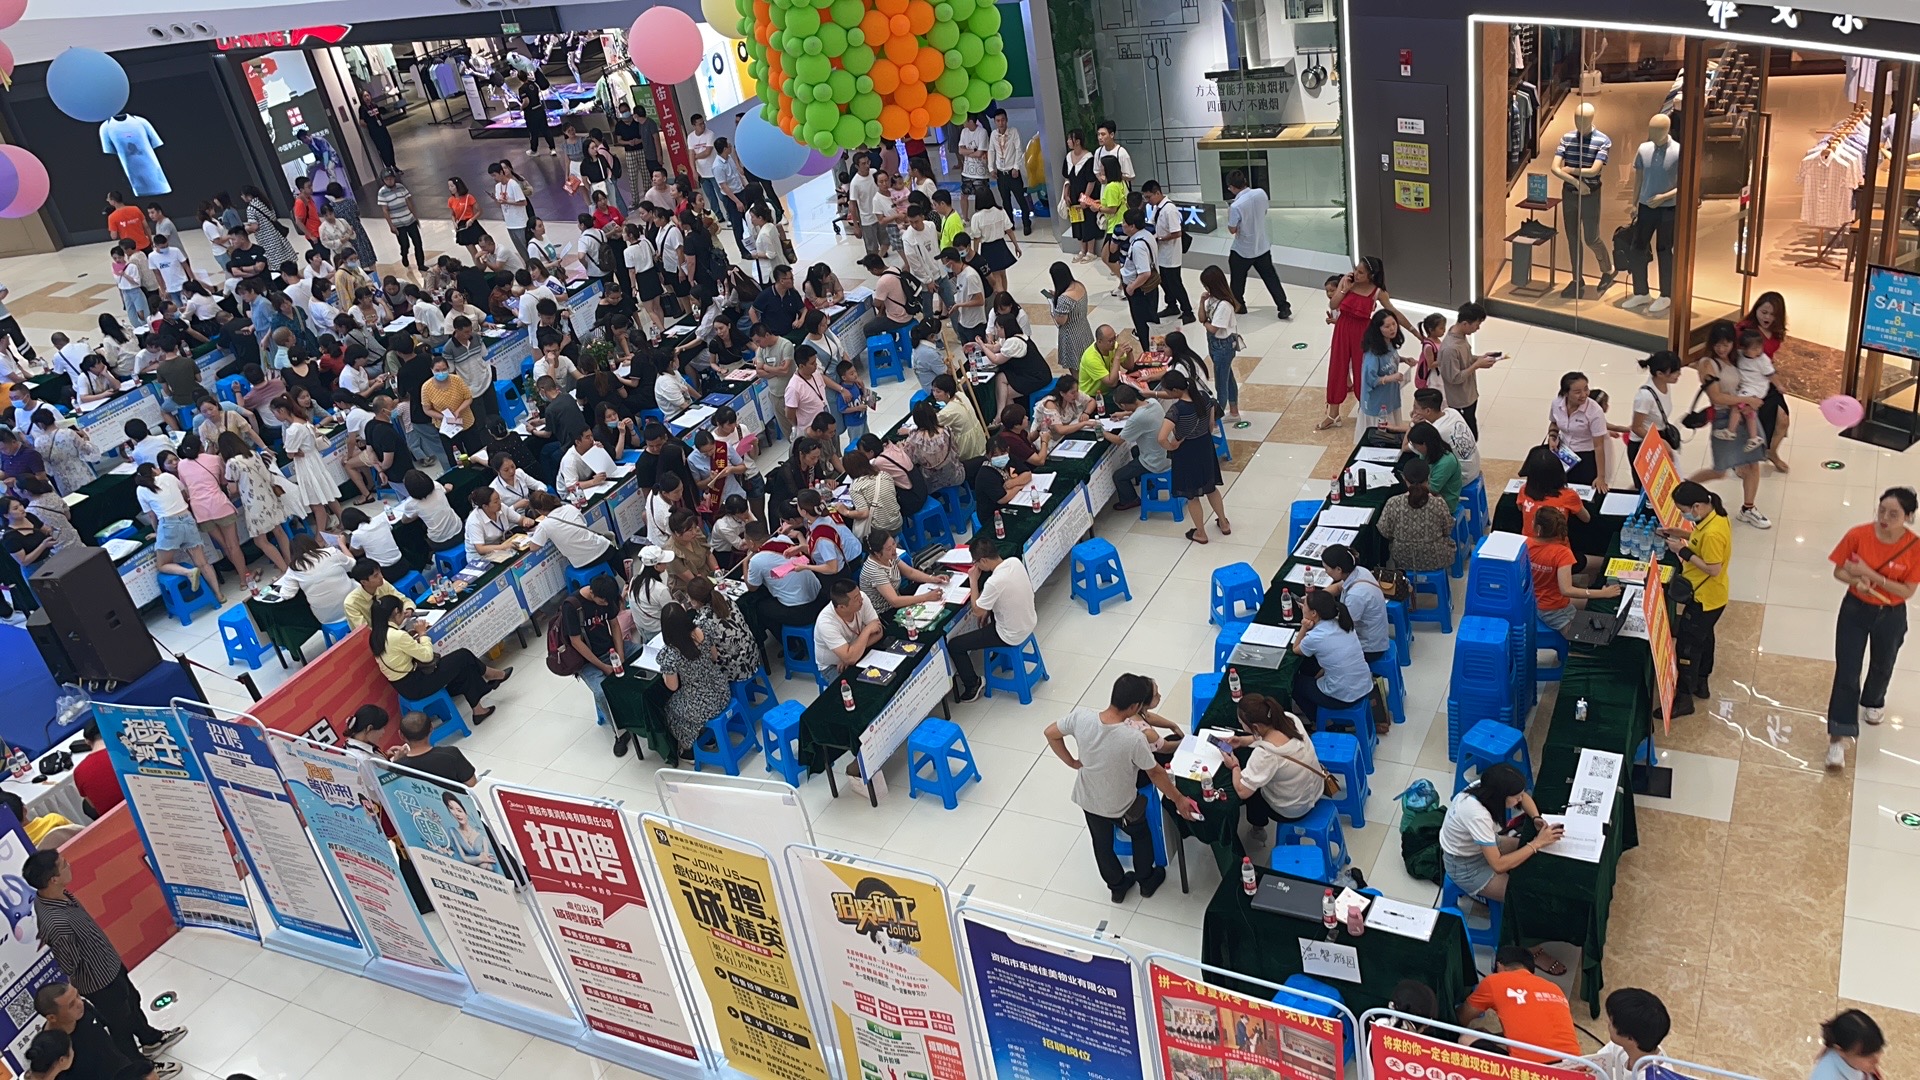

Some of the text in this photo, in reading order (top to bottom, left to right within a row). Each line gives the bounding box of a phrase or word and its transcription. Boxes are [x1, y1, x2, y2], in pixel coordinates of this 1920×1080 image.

[1196, 81, 1289, 97] 方太智能升降油烟机
[1207, 98, 1279, 112] 四面八方不跑烟
[655, 86, 681, 155] 街上苏宁
[1874, 295, 1920, 317] SALE
[206, 721, 244, 750] 招聘
[523, 820, 627, 885] 招聘
[673, 863, 724, 891] 虚位以待
[691, 857, 740, 881] JOIN US
[832, 892, 917, 932] 招贤纳士
[888, 923, 920, 939] Join Us
[991, 951, 1118, 998] 资阳市车城佳美物业有限公司
[1009, 1051, 1027, 1061] 水电工
[1042, 1036, 1092, 1062] 招聘岗位
